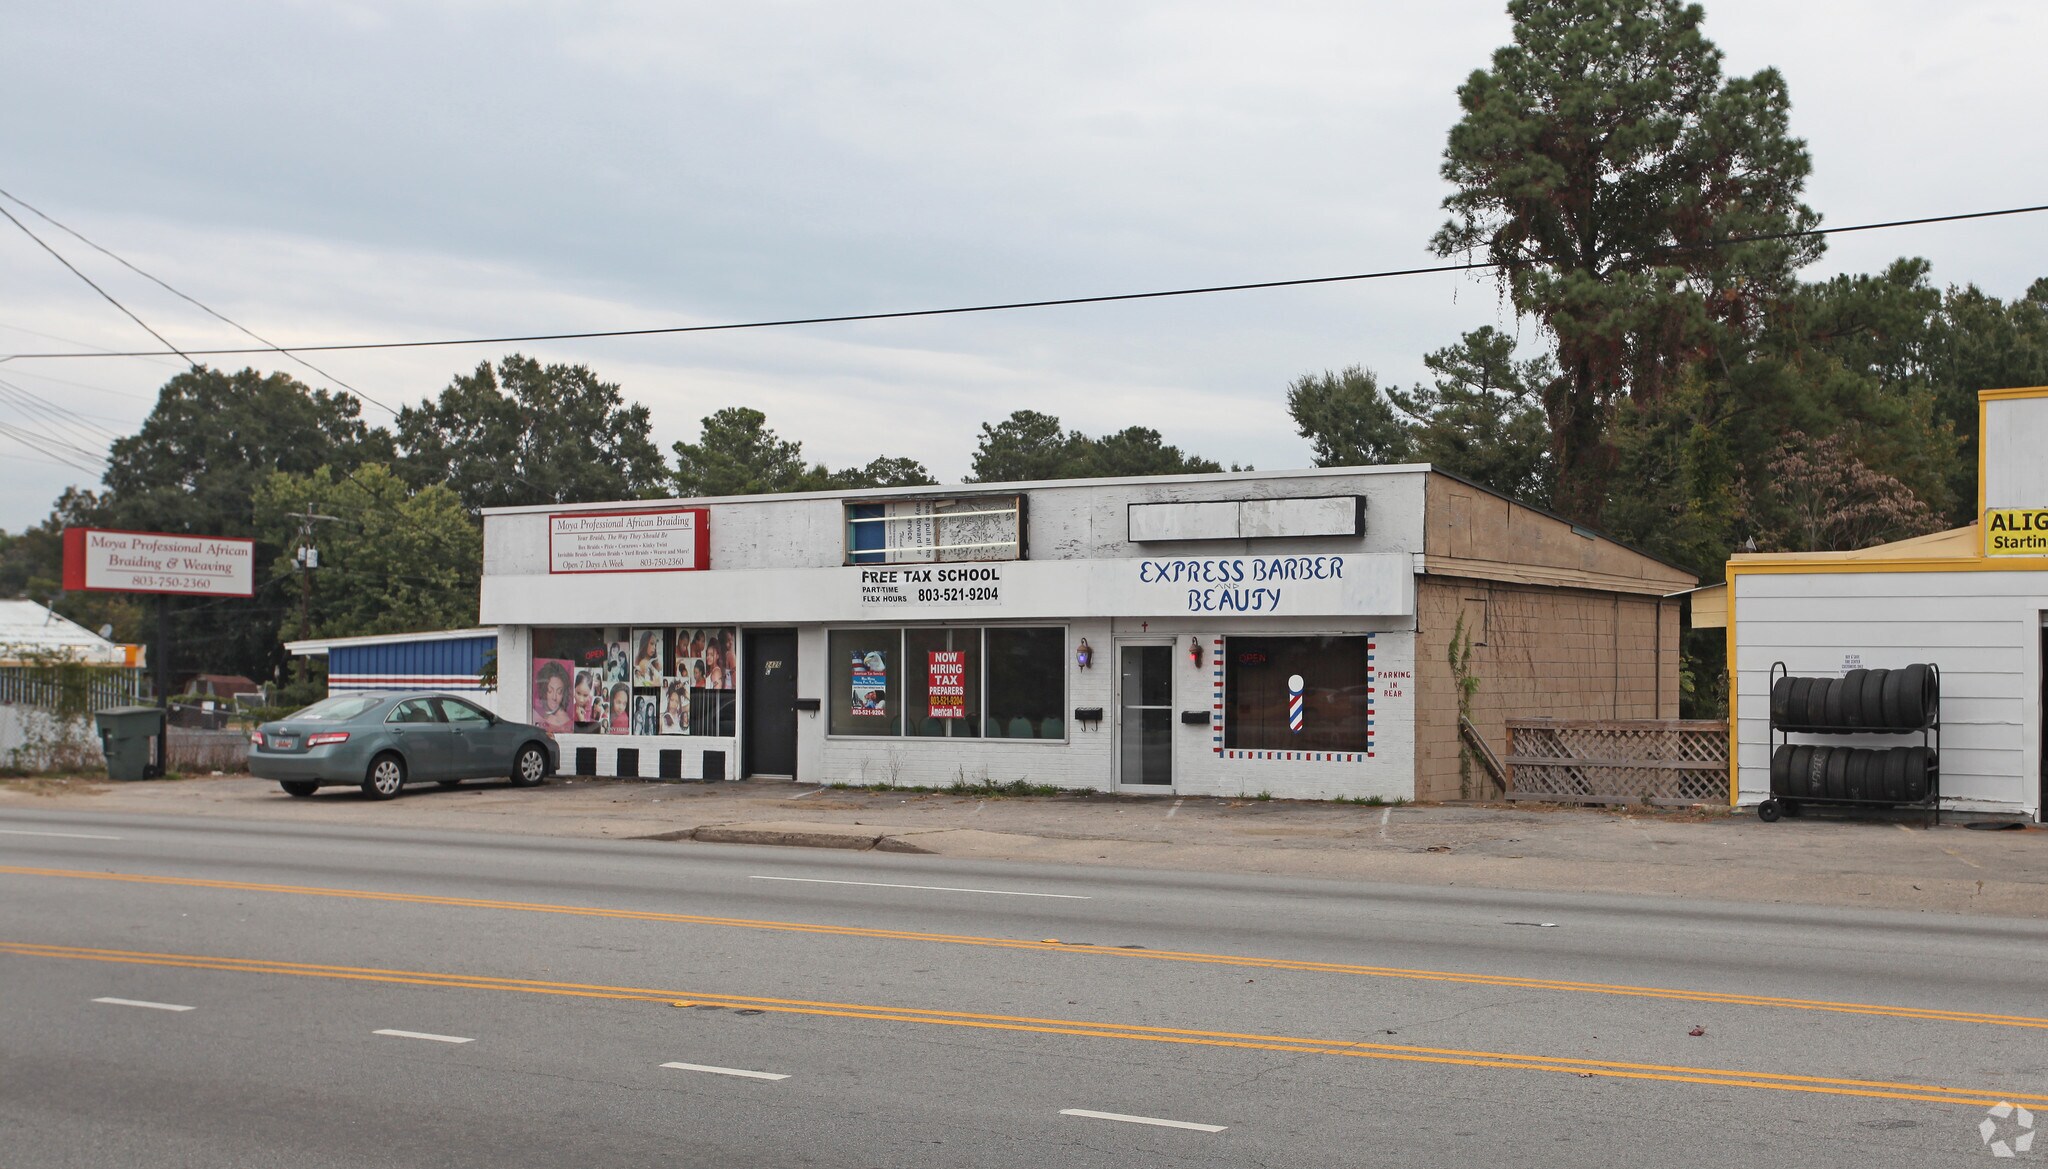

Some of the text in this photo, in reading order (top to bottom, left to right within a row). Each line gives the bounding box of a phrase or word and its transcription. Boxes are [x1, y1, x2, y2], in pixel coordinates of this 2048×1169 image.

[557, 515, 690, 531] Moya Professional African Braiding
[924, 523, 932, 536] pull
[617, 533, 628, 541] Way
[1994, 534, 2047, 549] Startin
[91, 535, 248, 557] Moya Professional African
[109, 554, 232, 573] Braiding & Weaving
[562, 559, 624, 570] Open 7 Days A Week
[640, 558, 684, 567] 803-750-2360
[862, 568, 1000, 583] FREE TAX SCHOOL
[1139, 556, 1344, 584] EXPRESS BARBER
[132, 576, 211, 589] 803-750-2360
[918, 587, 999, 602] 803-521-9204
[1188, 588, 1281, 612] BEAUTY
[585, 649, 604, 660] OPEN
[935, 652, 957, 663] NOW
[1238, 653, 1266, 664] OPEN
[930, 664, 963, 674] HIRING
[935, 675, 958, 685] TAX
[1377, 671, 1411, 679] PARKING
[929, 686, 964, 695] PREPARERS
[1383, 689, 1403, 697] REAR
[930, 695, 963, 705] 803-521-9204
[931, 706, 962, 717] American Tax
